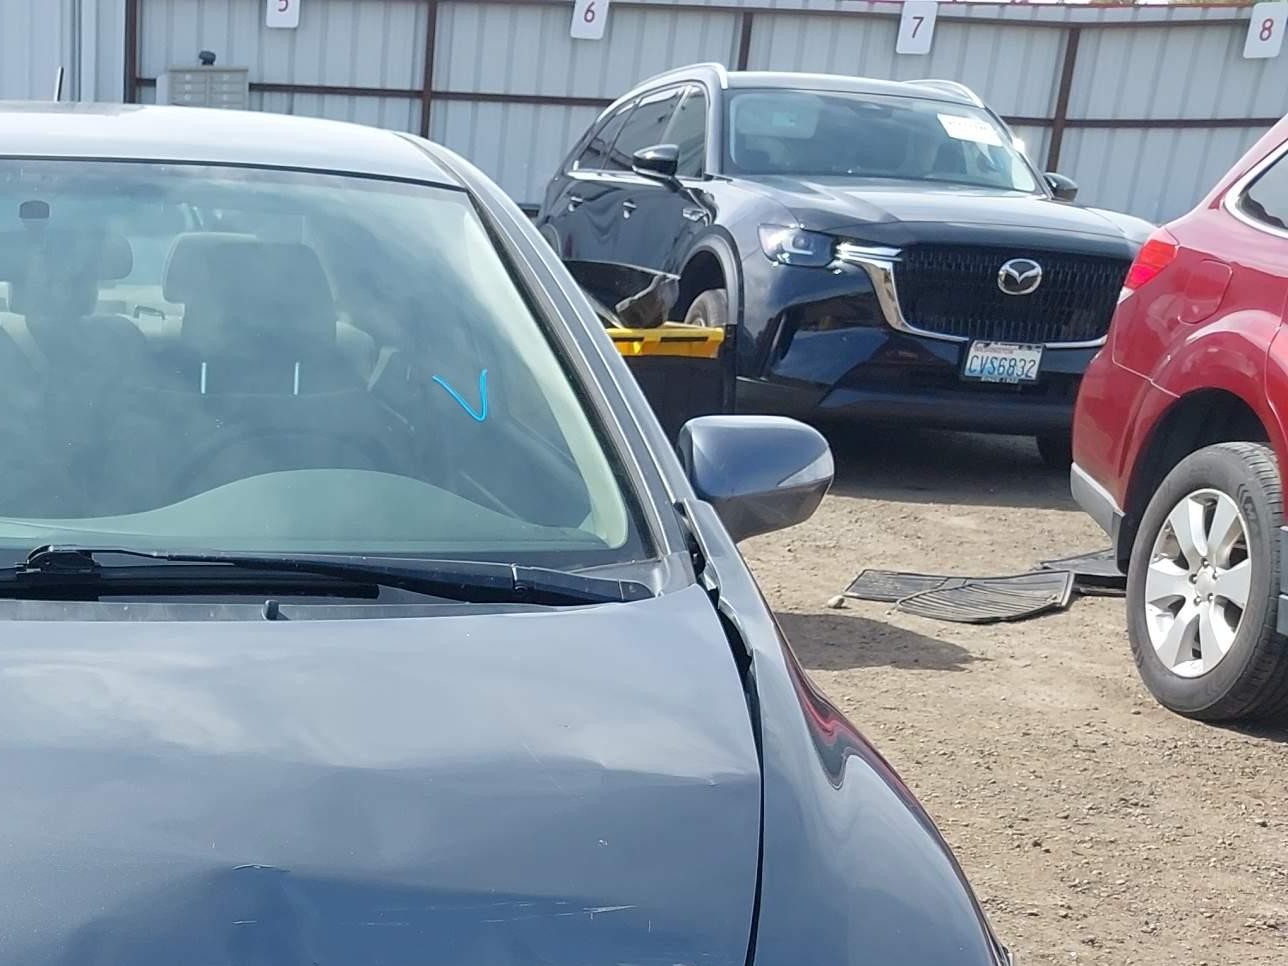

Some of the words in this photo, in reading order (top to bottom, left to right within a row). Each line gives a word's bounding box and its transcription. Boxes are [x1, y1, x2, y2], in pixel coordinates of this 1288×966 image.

[584, 1, 595, 23] 6
[912, 16, 924, 38] 7
[1259, 18, 1274, 42] 8
[968, 355, 1036, 378] CVS6832
